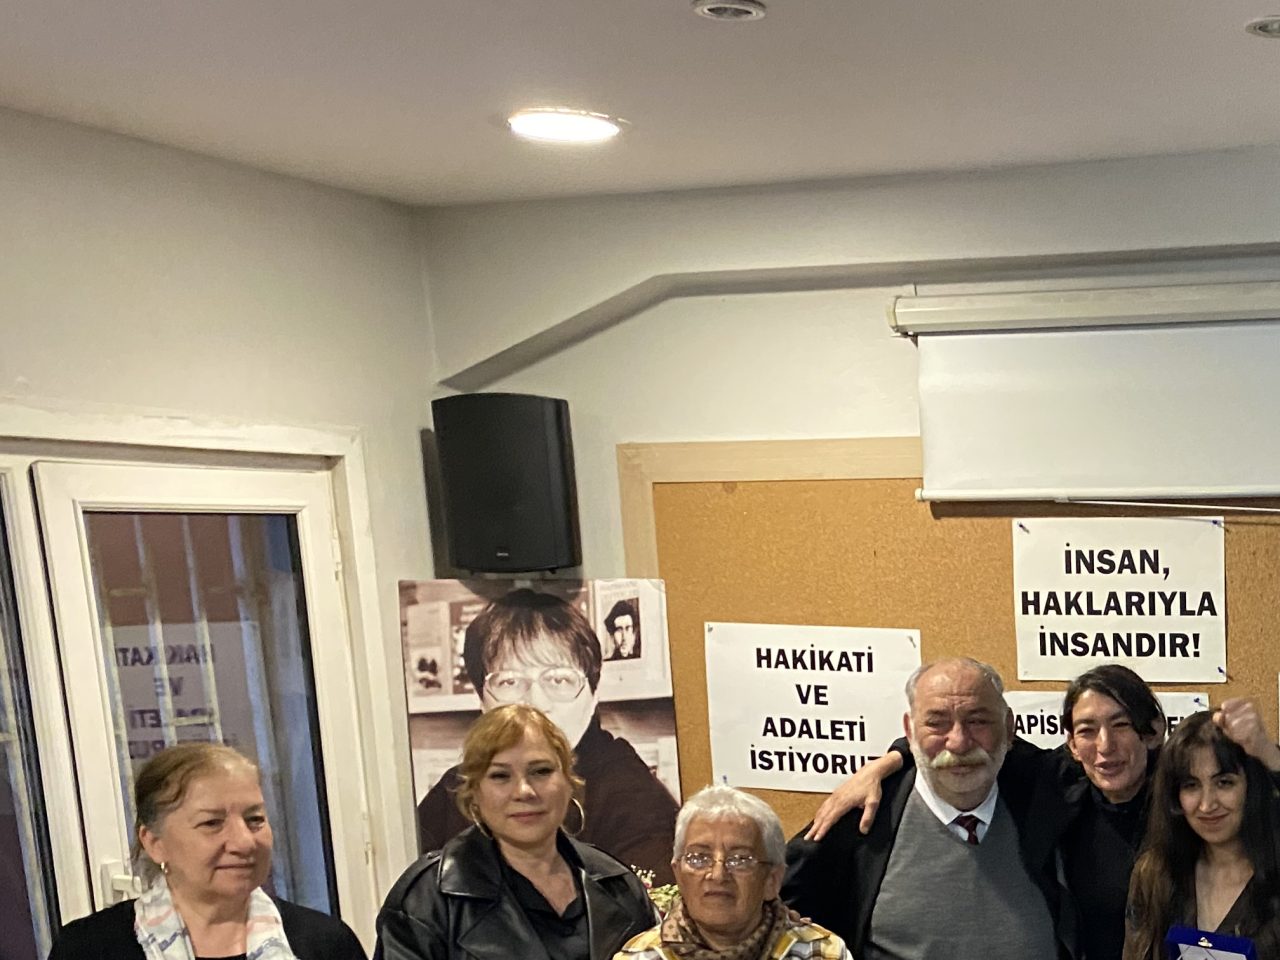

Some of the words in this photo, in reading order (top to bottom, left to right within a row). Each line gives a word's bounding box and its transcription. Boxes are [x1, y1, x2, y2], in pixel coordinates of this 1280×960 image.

[1064, 542, 1170, 580] İNSAN,
[1021, 591, 1218, 616] HAKLARIYLA
[1039, 625, 1200, 657] İNSANDIR!
[756, 643, 874, 673] HAKİKATİ
[795, 684, 829, 706] VE
[762, 715, 866, 742] ADALETİ
[750, 743, 881, 775] İSTİYORU
